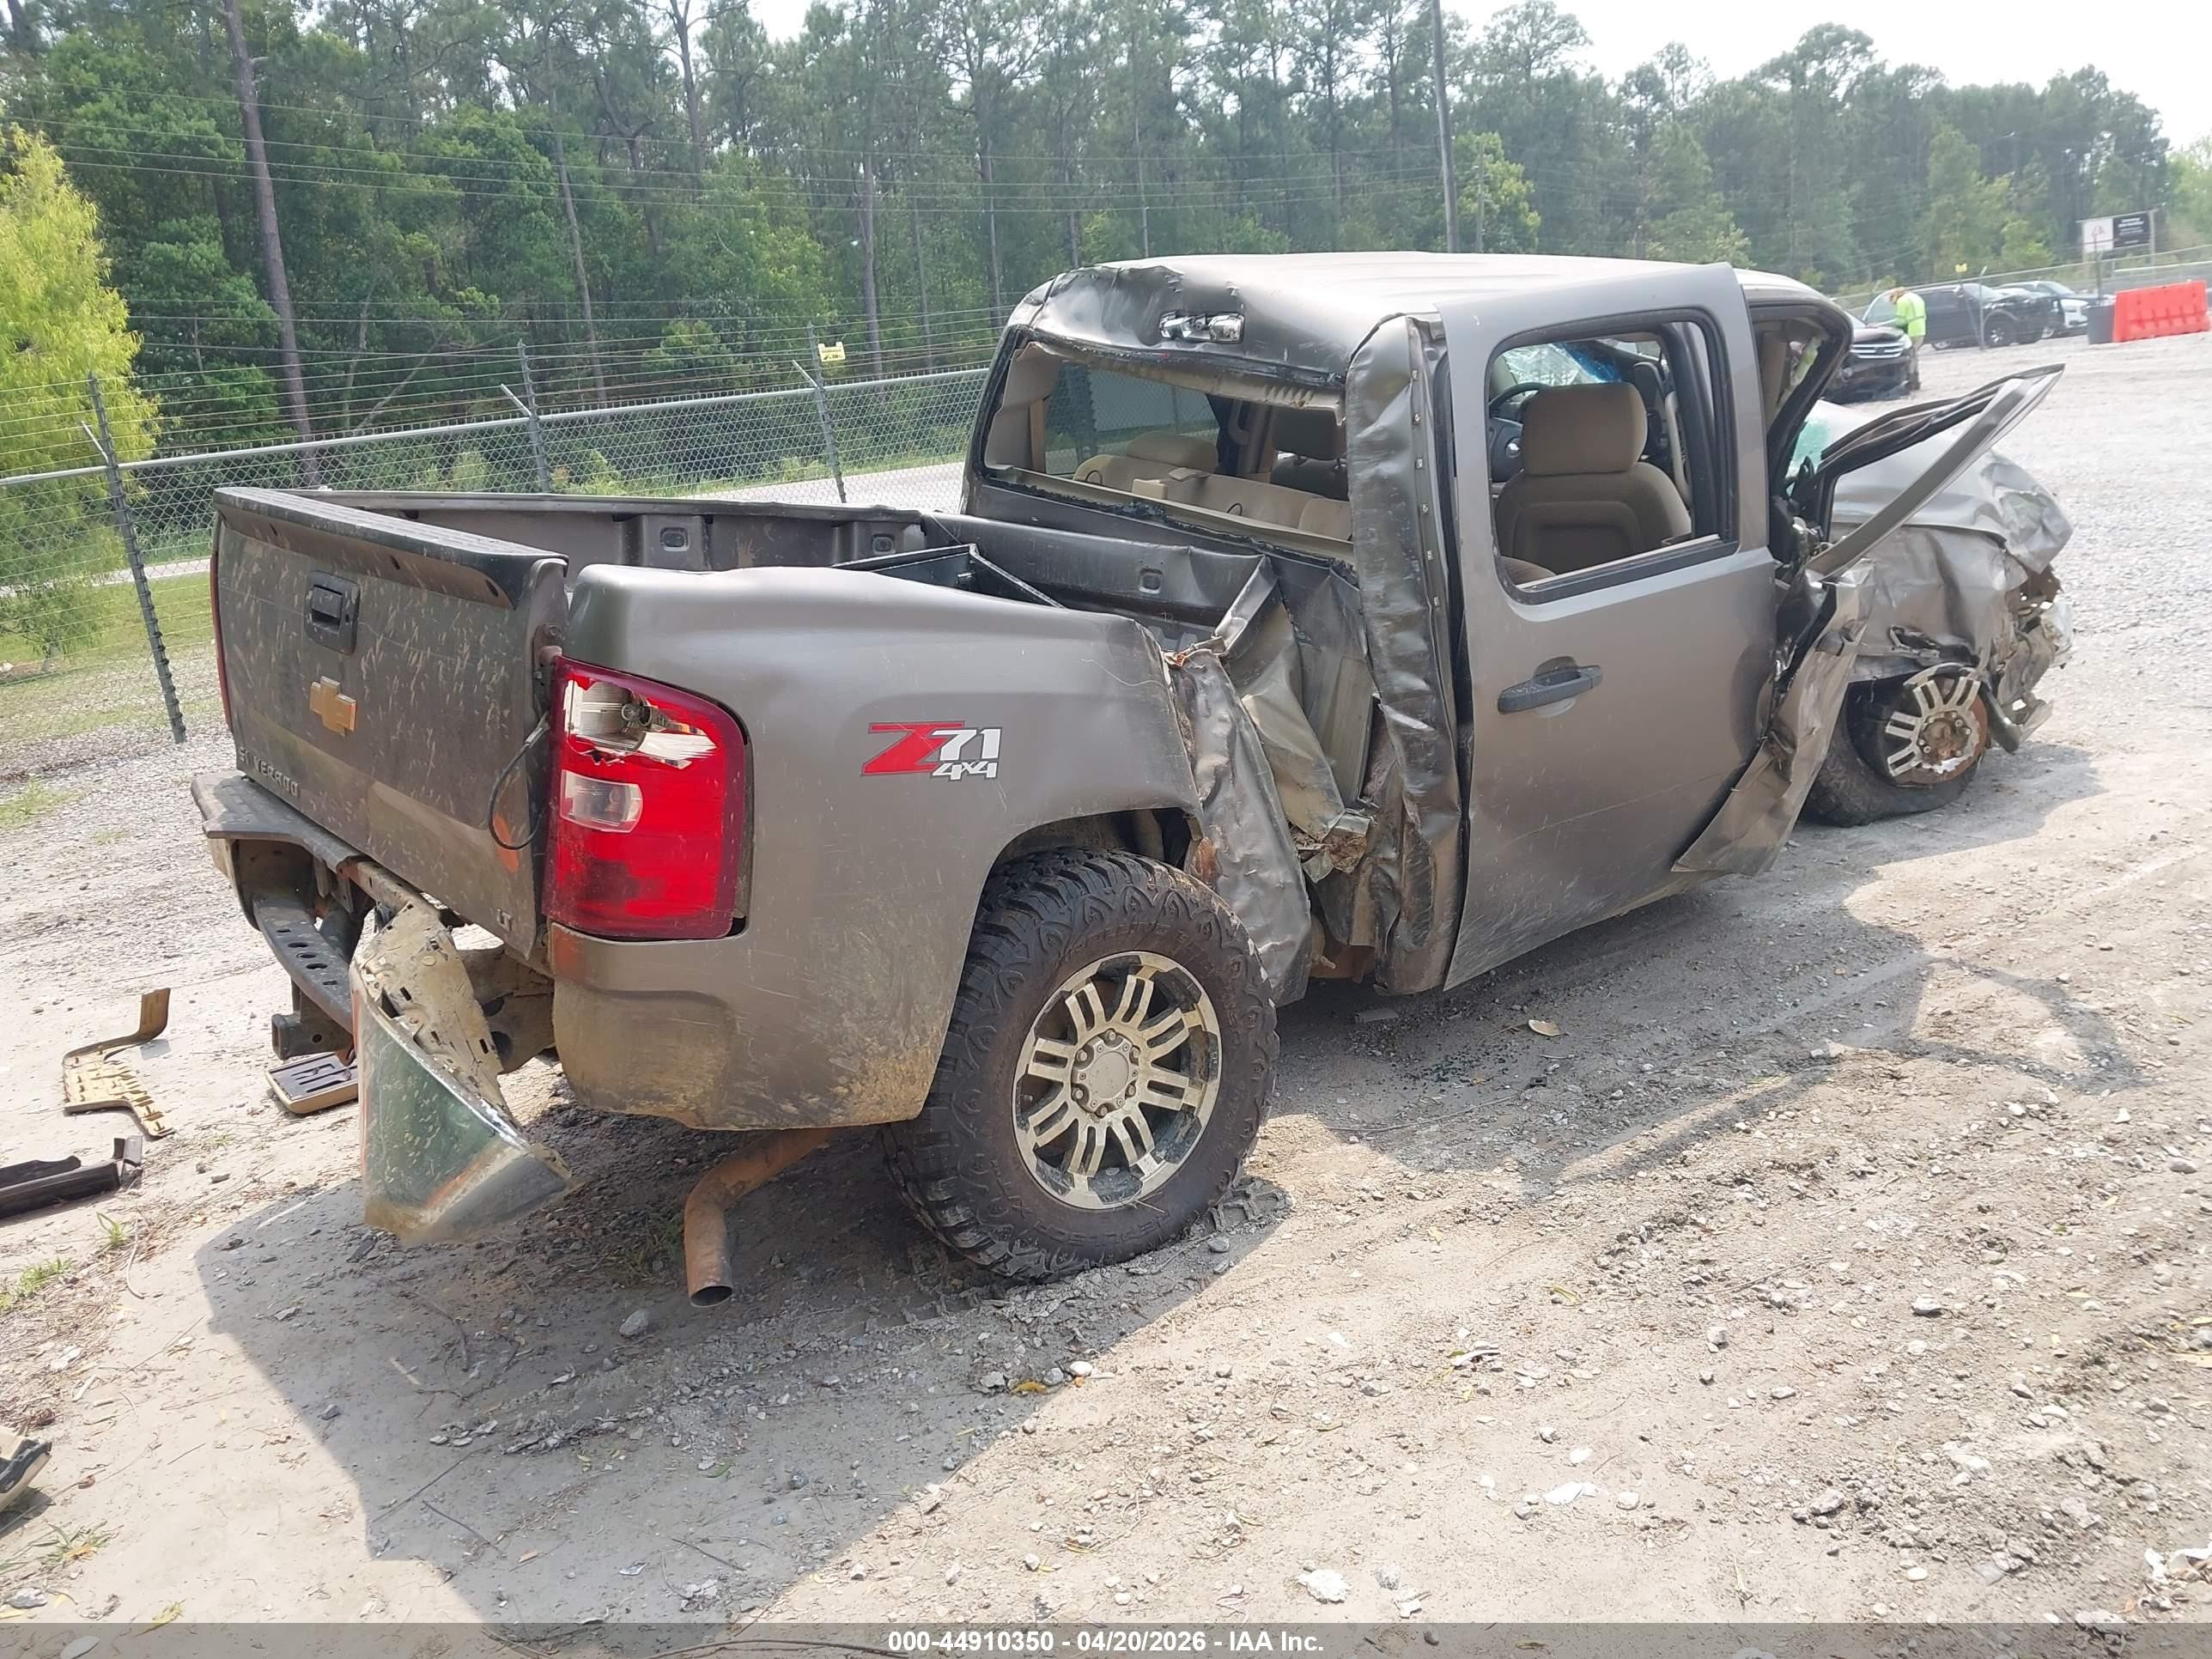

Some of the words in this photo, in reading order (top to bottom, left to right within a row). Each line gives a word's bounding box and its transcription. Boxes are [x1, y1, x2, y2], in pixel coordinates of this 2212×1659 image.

[240, 746, 298, 798] SIVERADO
[861, 721, 1002, 776] Z71
[492, 908, 512, 933] LT
